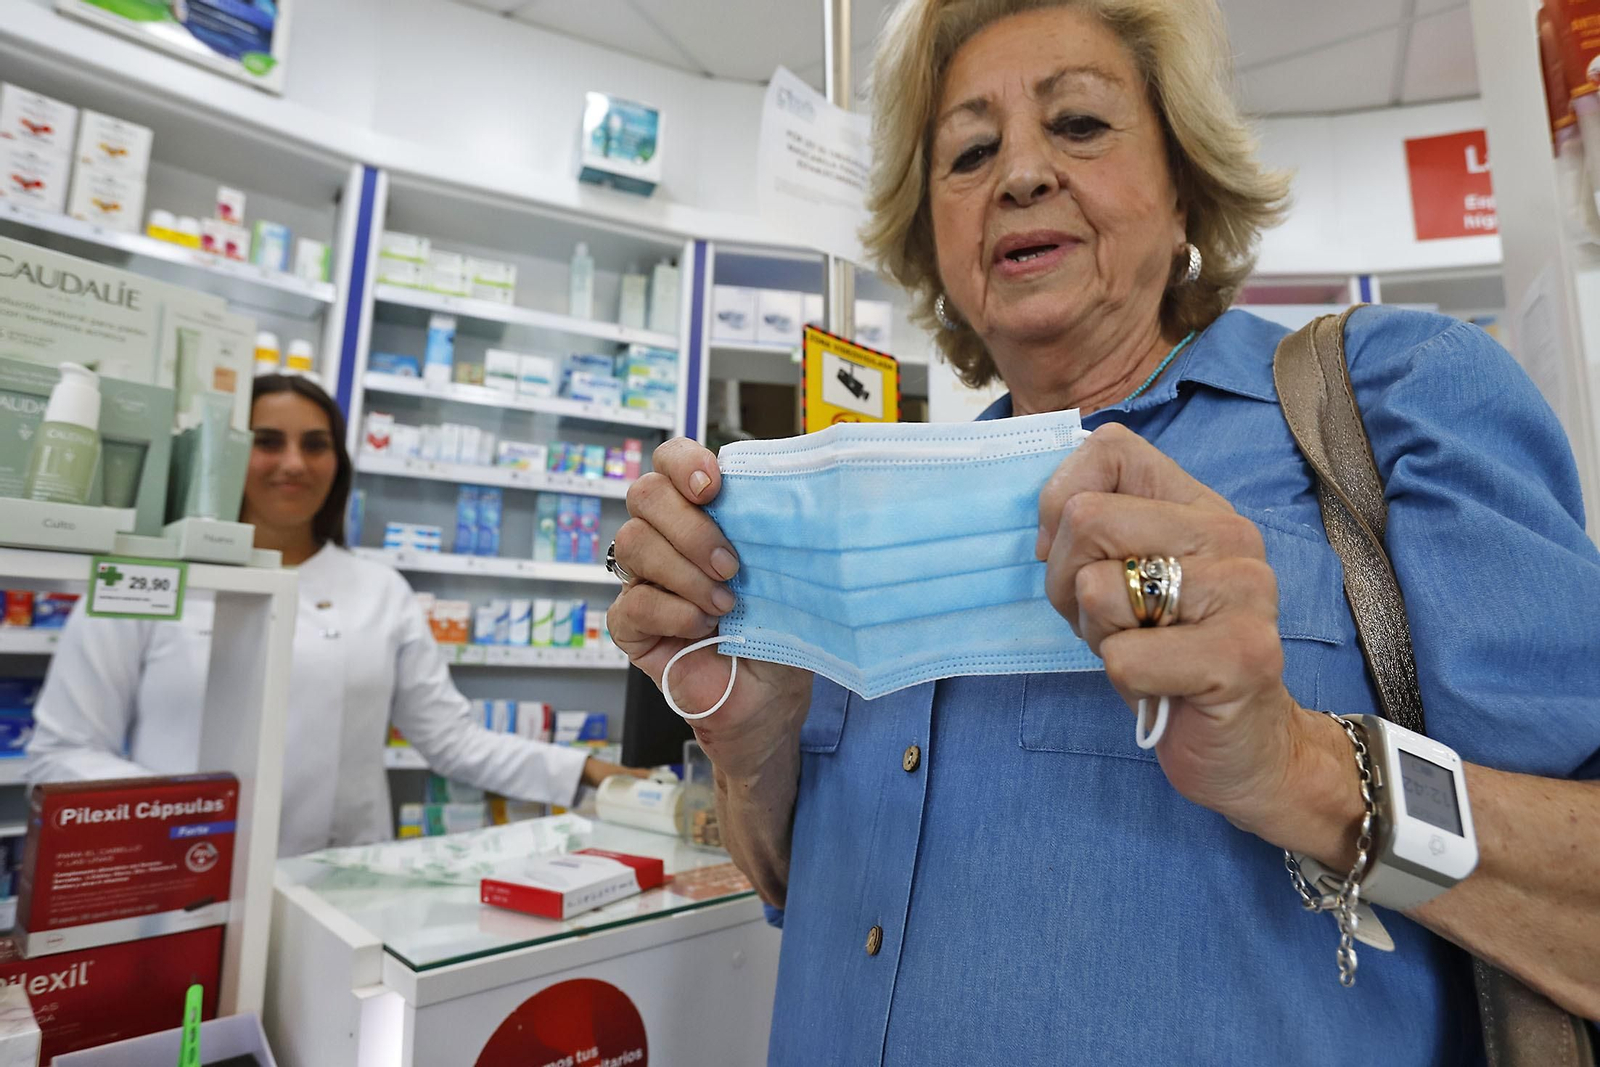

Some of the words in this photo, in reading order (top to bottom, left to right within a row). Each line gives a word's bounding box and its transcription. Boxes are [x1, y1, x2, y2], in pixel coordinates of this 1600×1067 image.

[128, 576, 171, 592] 29,90
[60, 805, 131, 826] Pilexil
[135, 797, 226, 822] Cápsulas
[575, 1045, 599, 1064] tus
